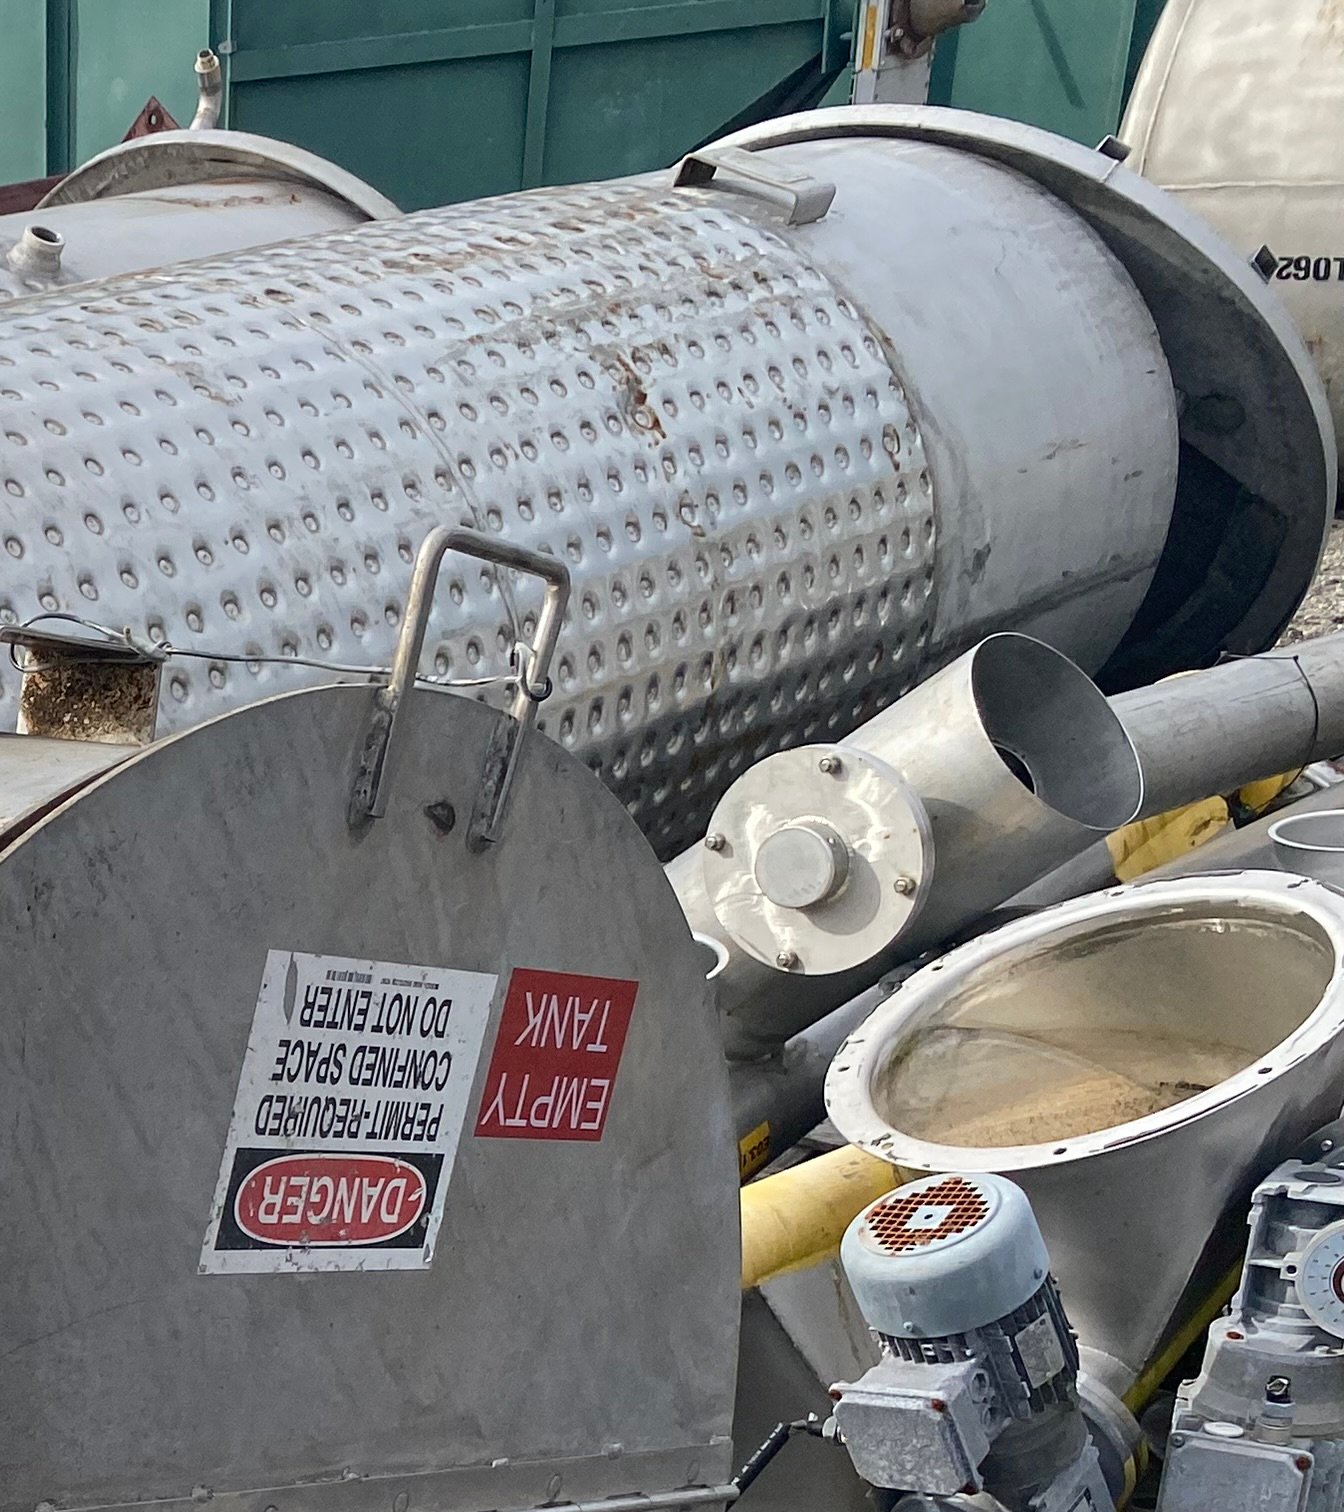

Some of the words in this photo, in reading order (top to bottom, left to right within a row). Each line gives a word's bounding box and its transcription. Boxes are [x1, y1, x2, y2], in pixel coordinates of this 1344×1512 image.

[299, 985, 371, 1033] ENTER
[371, 991, 417, 1035] NOT
[419, 997, 452, 1039] DO
[514, 991, 611, 1053] TANK
[271, 1039, 347, 1086] SPACE
[349, 1044, 452, 1091] CONFINED
[254, 1094, 444, 1142] PERMIT-REQUIRED
[480, 1072, 610, 1131] EMPTY
[257, 1175, 408, 1224] DANGER
